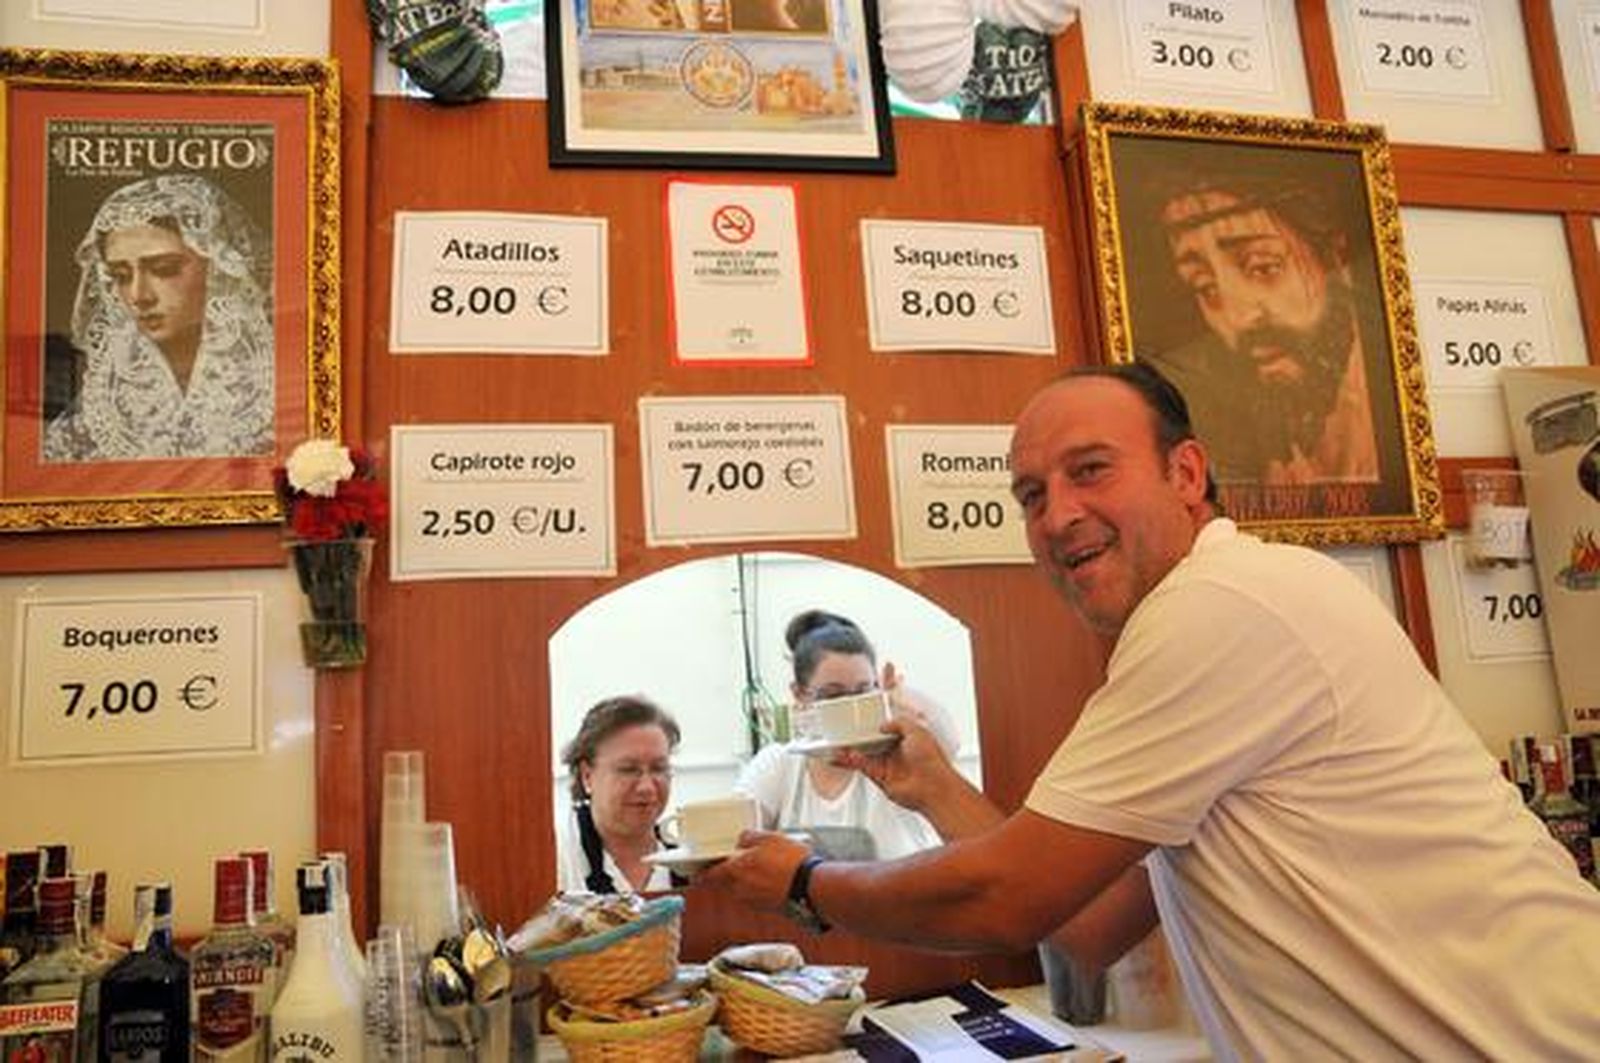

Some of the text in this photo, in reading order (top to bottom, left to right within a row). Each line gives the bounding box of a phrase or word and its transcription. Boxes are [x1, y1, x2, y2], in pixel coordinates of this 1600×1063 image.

[1168, 2, 1224, 23] Pilato
[1151, 40, 1252, 72] 3,00 €
[1376, 42, 1467, 69] 2,00 €
[69, 137, 256, 170] REFUGIO
[442, 238, 560, 263] Atadillos
[894, 246, 1019, 270] Saquetines
[430, 285, 568, 316] 8,00 €
[901, 290, 1021, 318] 8,00 €
[1445, 341, 1536, 367] 5,00 €
[723, 422, 741, 433] de
[430, 451, 576, 474] Capirote rojo
[682, 457, 815, 494] 7,00 €
[921, 453, 1012, 473] Romani
[421, 506, 587, 537] 2,50 €/U.
[926, 501, 1005, 532] 8,00
[1484, 593, 1542, 623] 7,00
[63, 625, 220, 651] Boquerones
[60, 676, 219, 719] 7,00 €
[272, 1032, 336, 1060] ALIBU
